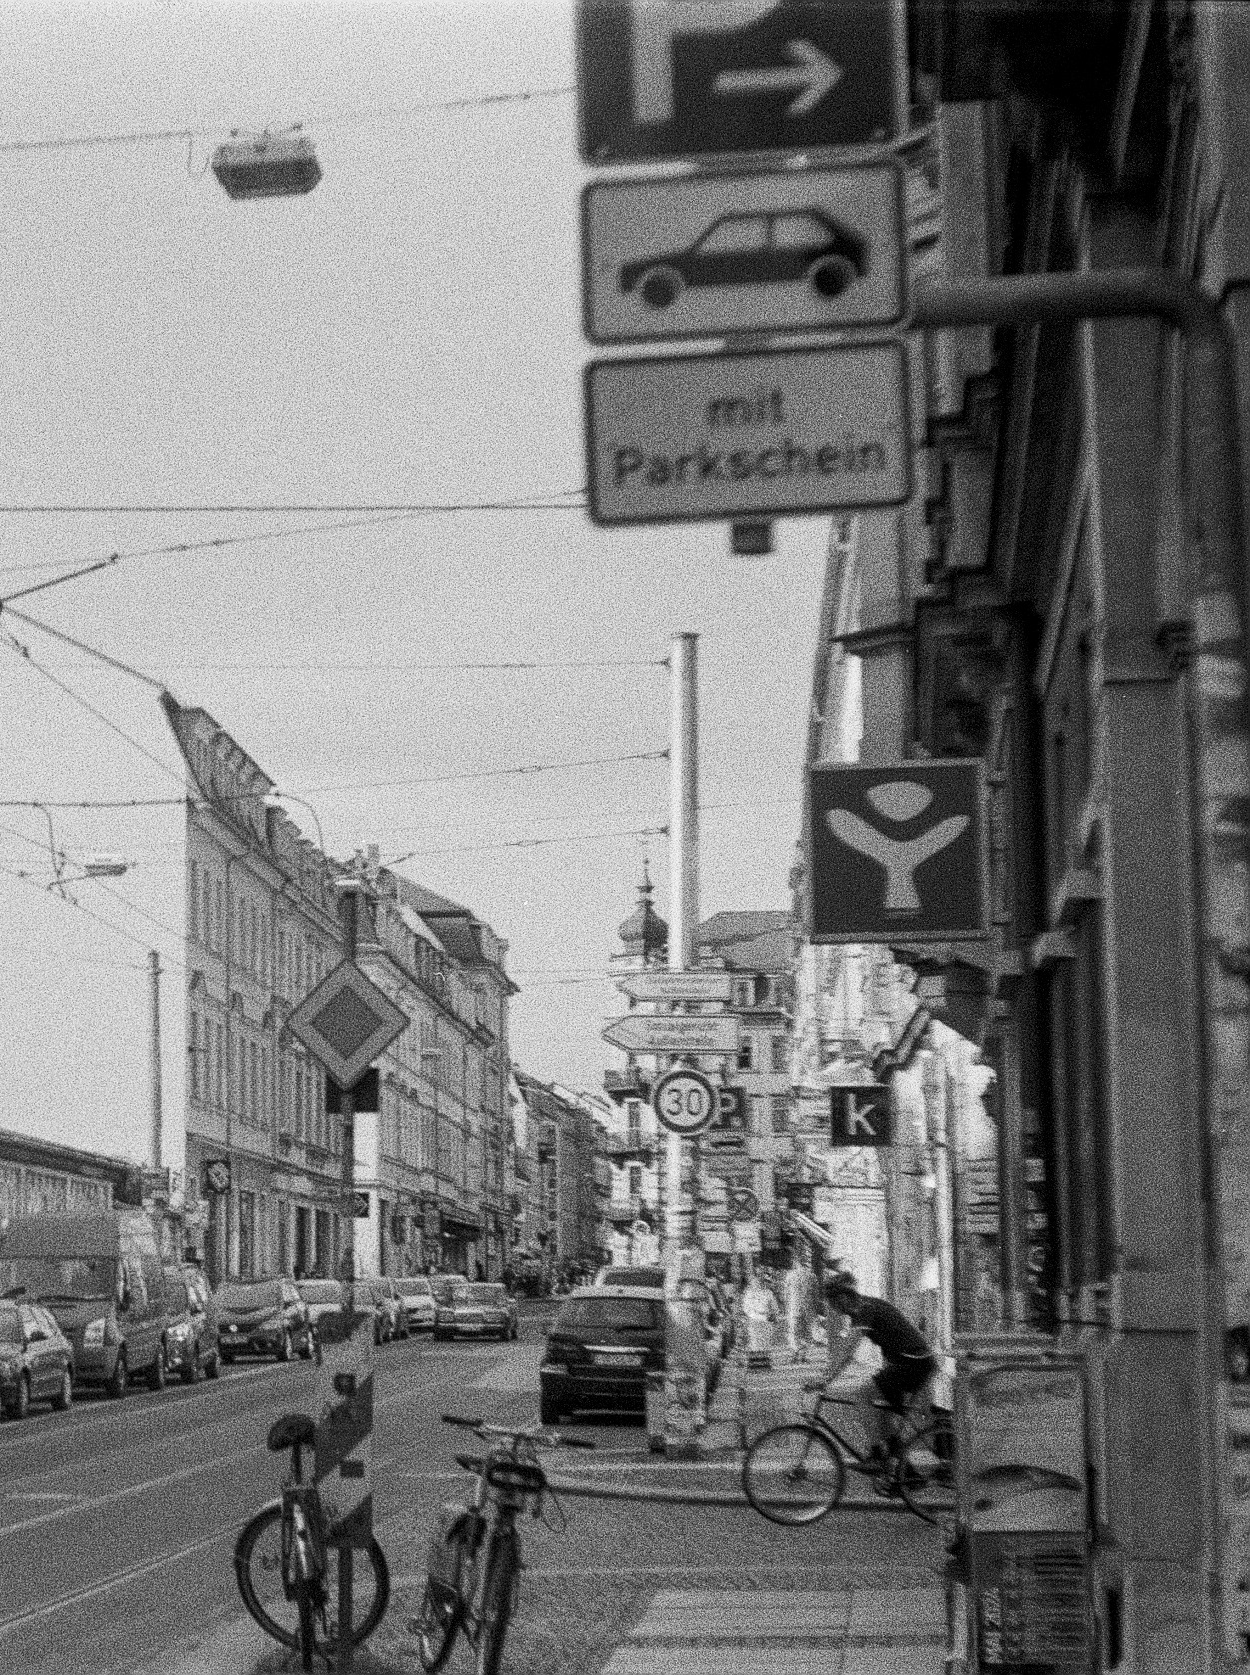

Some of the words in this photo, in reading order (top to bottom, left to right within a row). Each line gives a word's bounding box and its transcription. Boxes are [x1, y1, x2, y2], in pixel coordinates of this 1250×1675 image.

[707, 388, 784, 426] mit
[613, 436, 886, 487] Parkschein
[666, 1088, 703, 1117] 30
